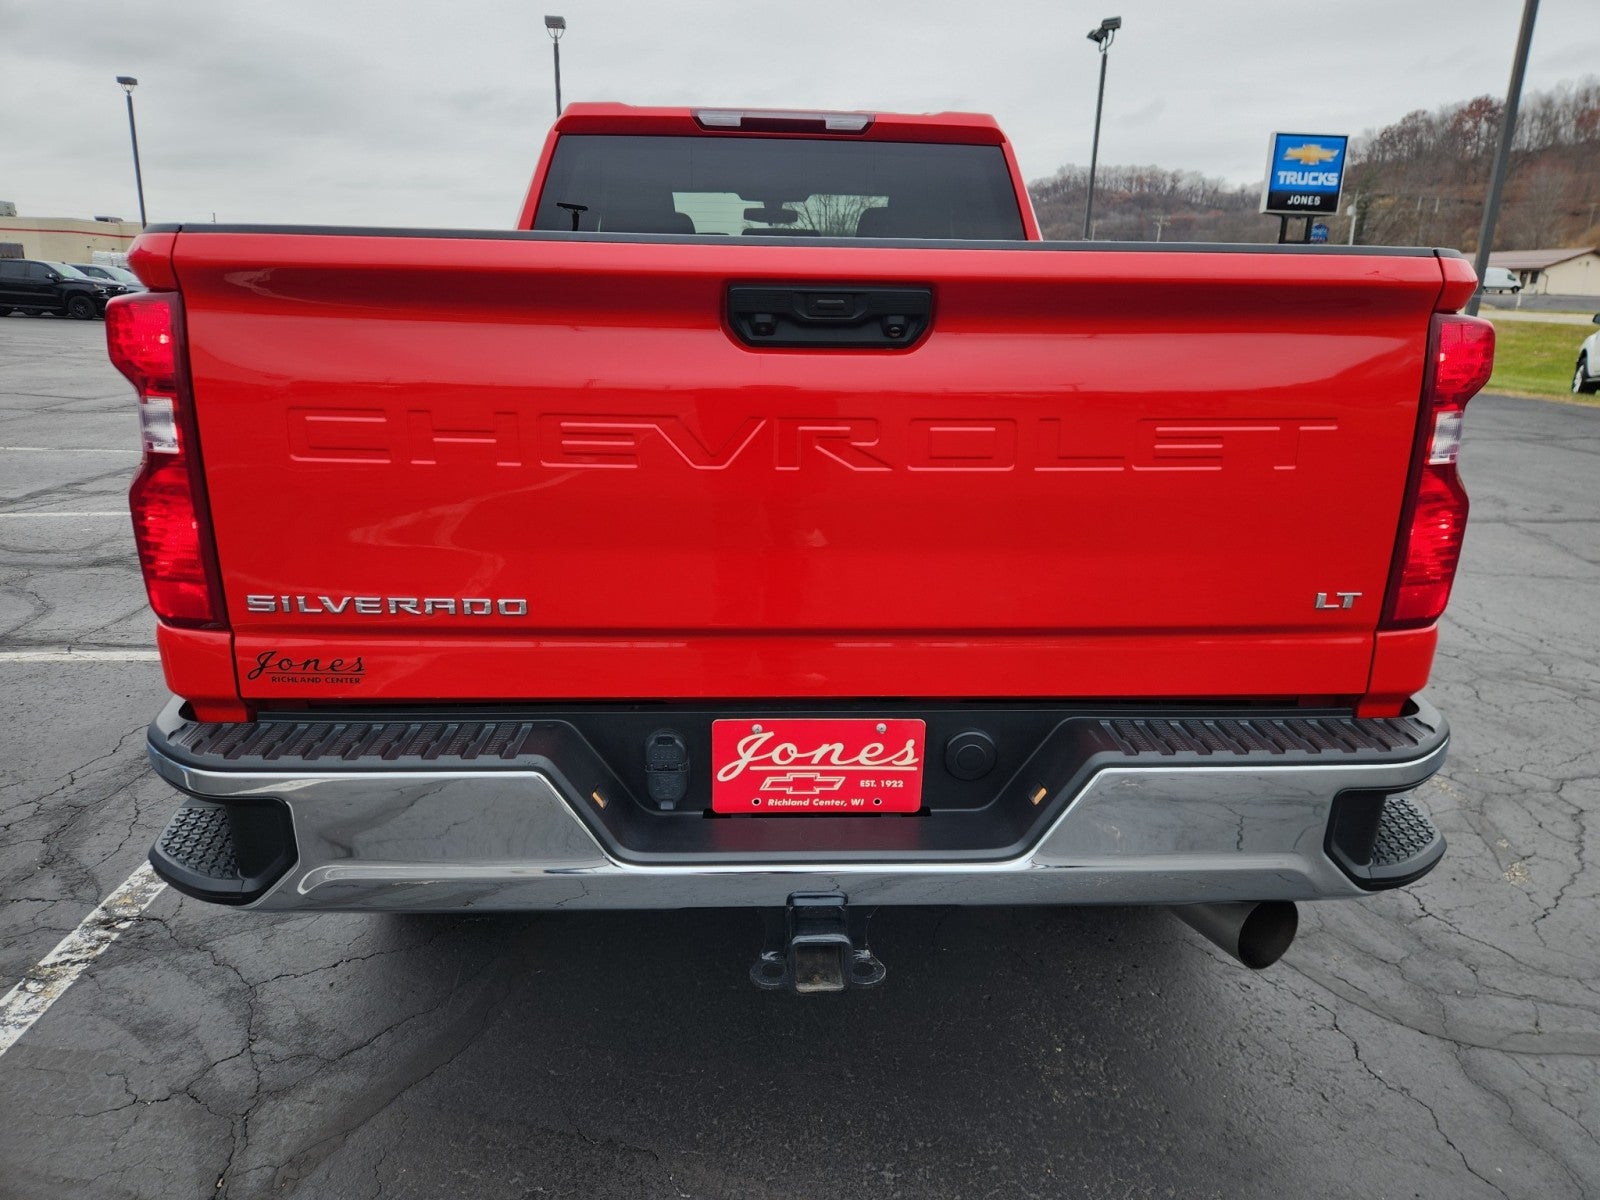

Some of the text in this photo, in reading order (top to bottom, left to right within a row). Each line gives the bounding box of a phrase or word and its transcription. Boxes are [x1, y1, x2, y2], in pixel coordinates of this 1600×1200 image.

[1277, 171, 1339, 186] TRUCKS
[1287, 195, 1321, 206] JONES
[287, 407, 1339, 471] CHEVROLET
[246, 594, 528, 615] SILVERADO
[1315, 592, 1362, 609] LT
[247, 650, 365, 680] Jones
[271, 676, 361, 684] RICHLAND CENTER
[717, 731, 919, 782] Jones
[860, 780, 904, 788] EST. 1922
[767, 798, 866, 808] Richland Center, WI
